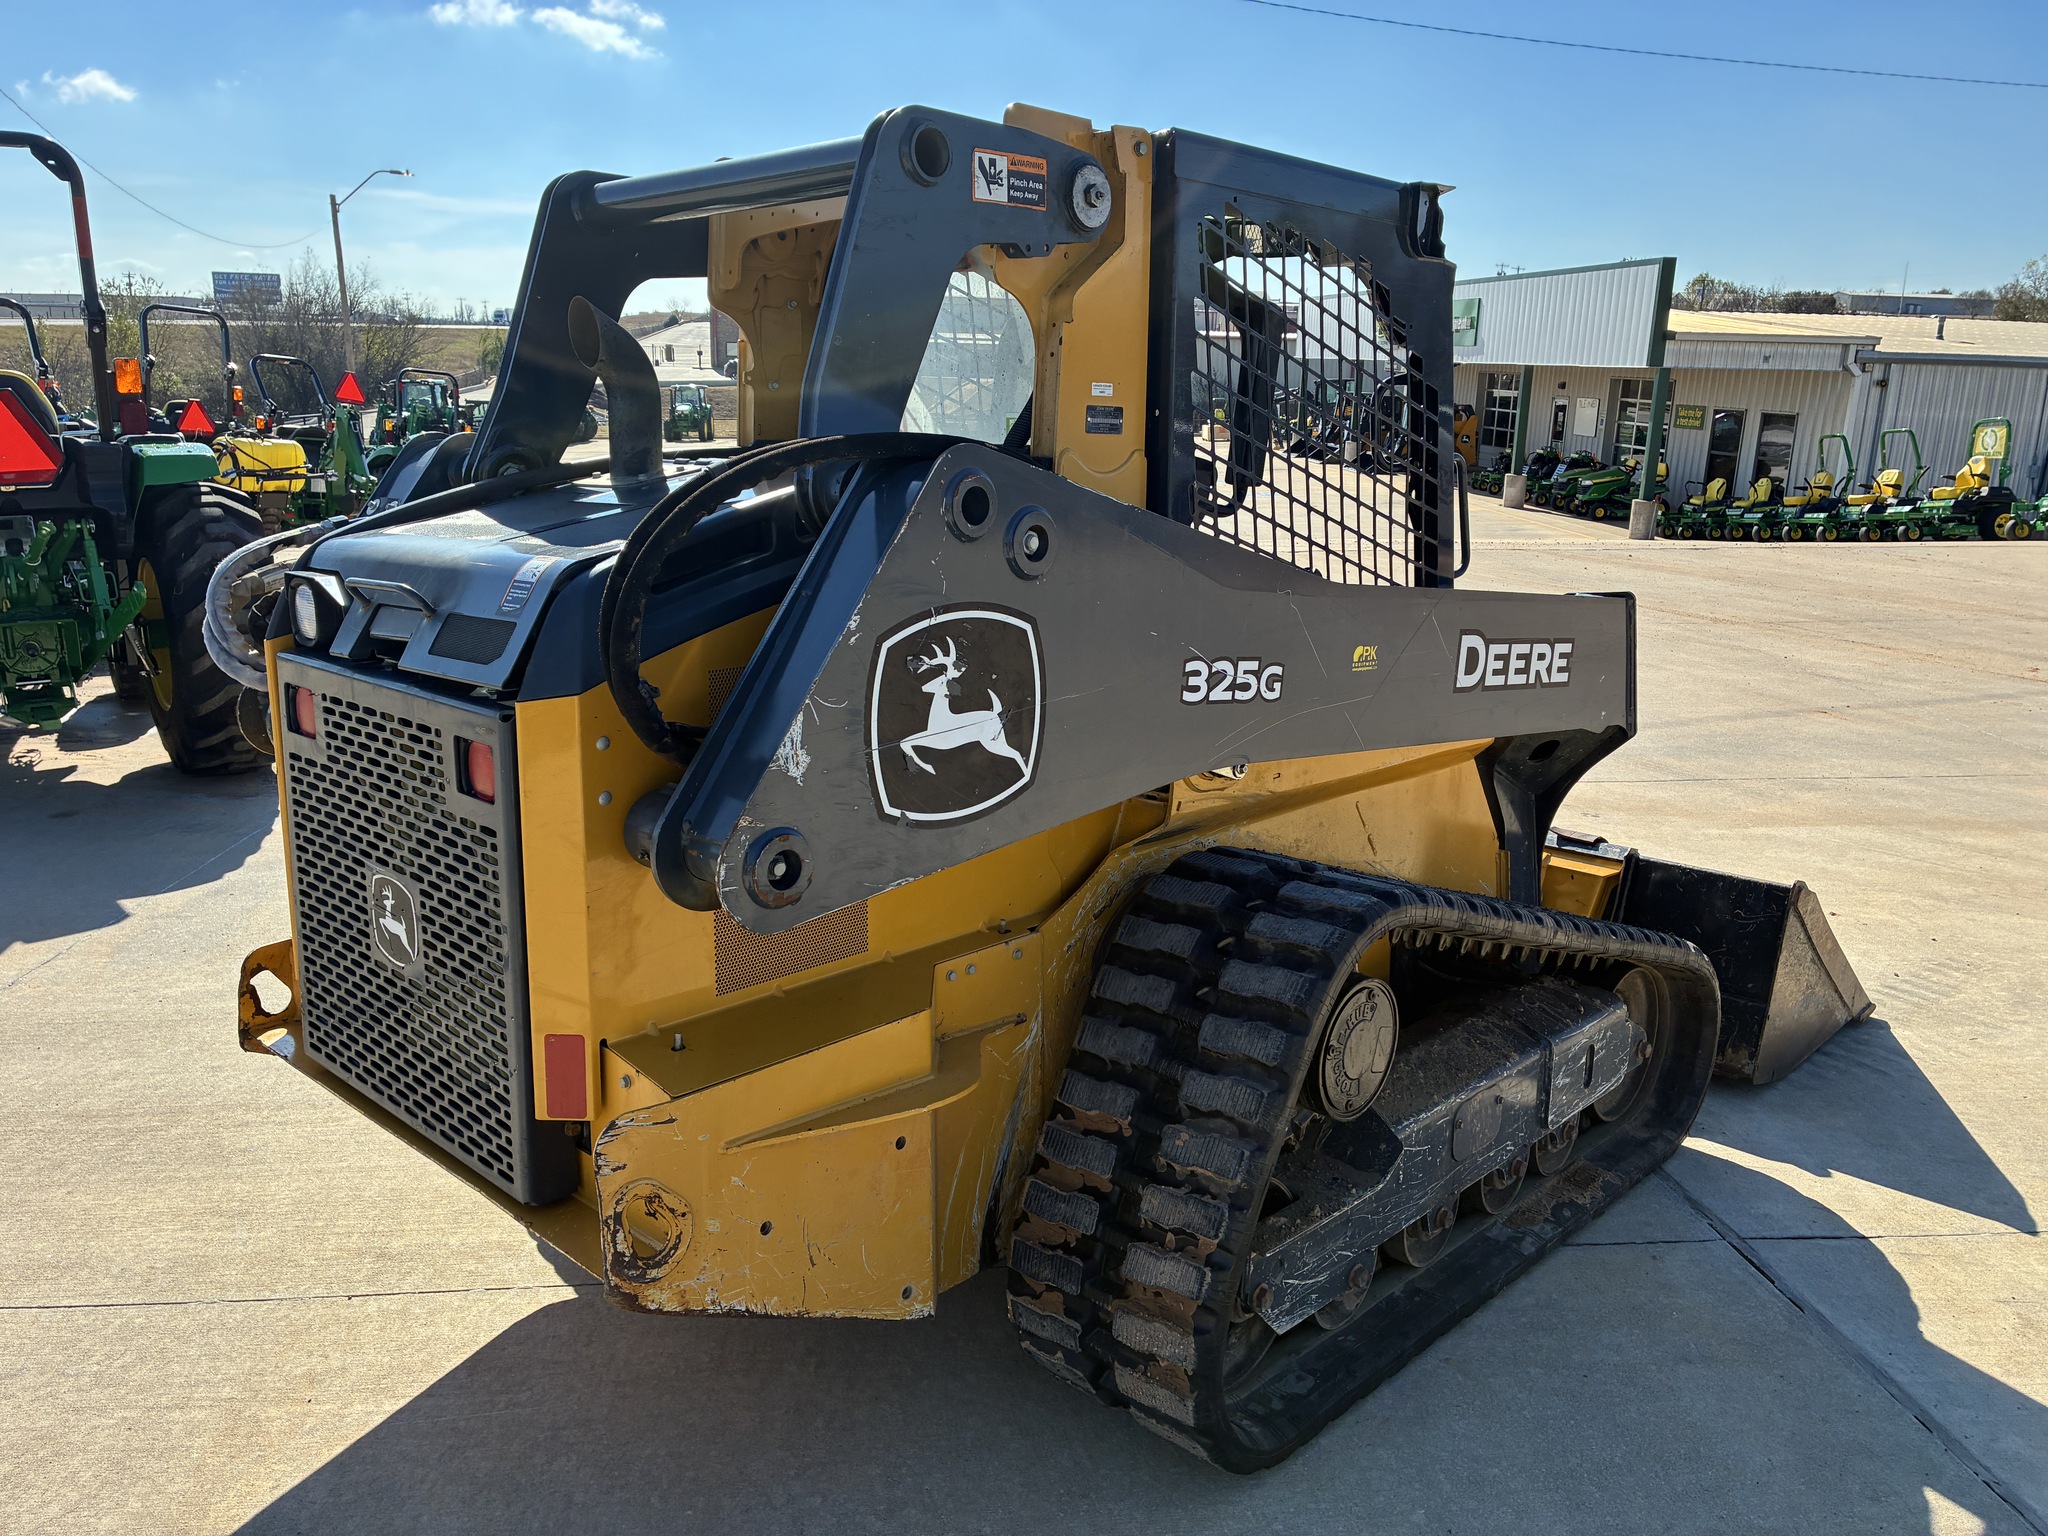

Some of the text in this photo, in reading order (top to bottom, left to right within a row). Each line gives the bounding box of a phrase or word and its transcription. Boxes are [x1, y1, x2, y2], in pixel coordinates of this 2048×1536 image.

[1016, 159, 1044, 170] WARNING
[1009, 177, 1043, 190] Pinch Area
[1009, 189, 1039, 201] Keep Away
[1678, 407, 1688, 417] Take
[1695, 408, 1703, 418] for
[1680, 417, 1689, 426] test
[1454, 632, 1574, 690] DEERE
[1181, 658, 1284, 704] 325G
